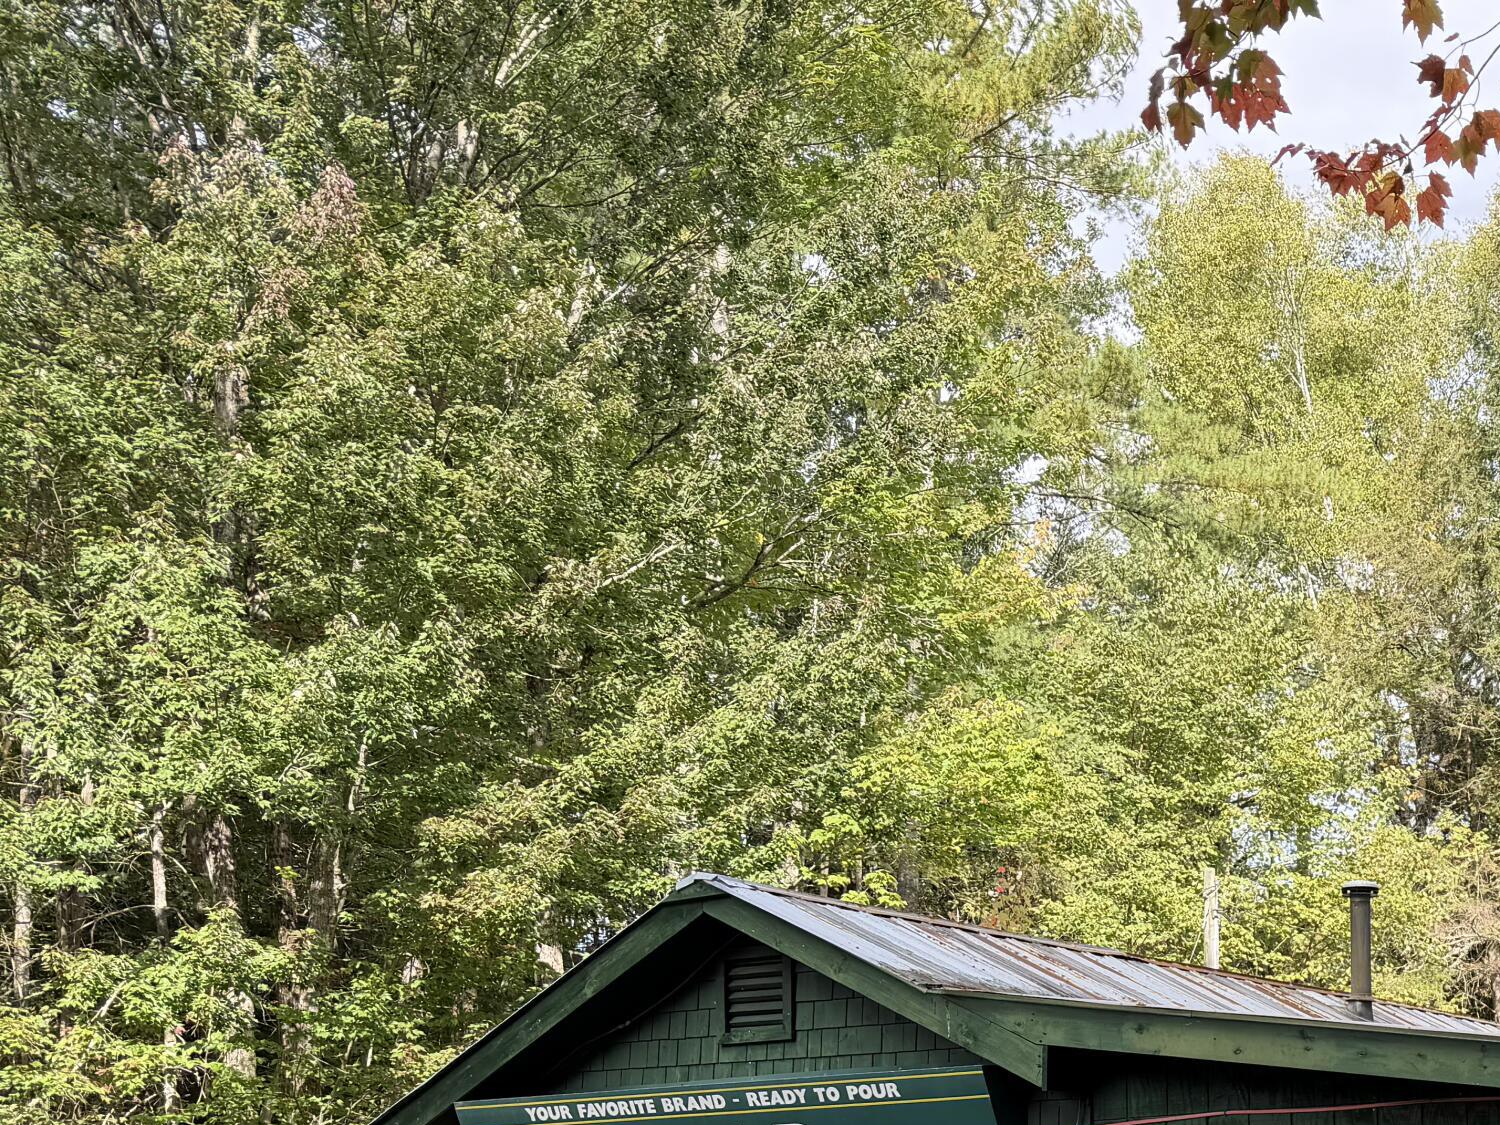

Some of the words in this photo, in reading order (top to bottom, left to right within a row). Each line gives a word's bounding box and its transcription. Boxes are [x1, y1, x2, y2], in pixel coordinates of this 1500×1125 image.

[525, 1105, 572, 1123] YOUR
[577, 1098, 657, 1120] FAVORITE
[662, 1093, 726, 1114] BRAND
[745, 1087, 806, 1108] READY
[812, 1086, 840, 1103] TO
[846, 1081, 901, 1101] POUR
